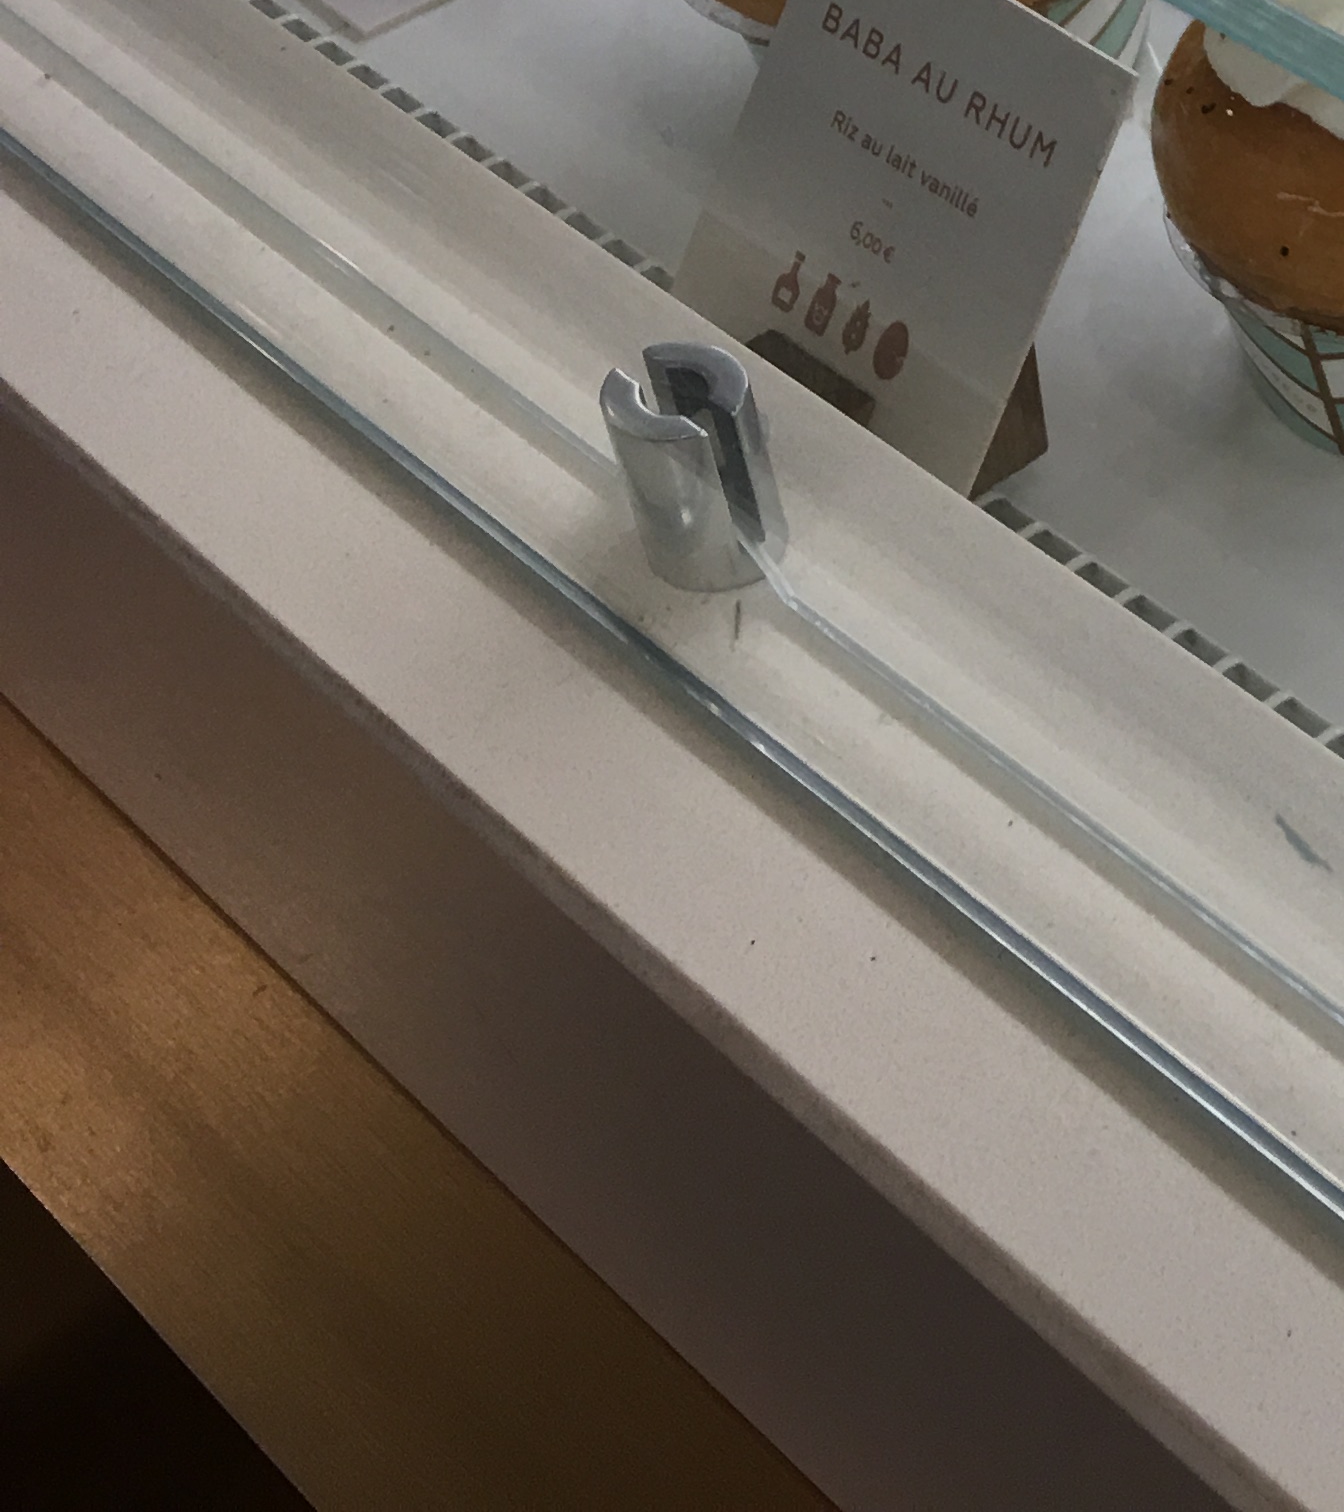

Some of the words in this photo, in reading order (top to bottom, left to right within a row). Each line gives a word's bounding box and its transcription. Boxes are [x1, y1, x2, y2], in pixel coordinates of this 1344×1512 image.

[822, 3, 902, 74] BABA
[911, 62, 959, 104] AU
[964, 91, 1058, 168] RHUM
[831, 110, 860, 141] Riz
[861, 134, 883, 157] au
[886, 145, 917, 178] lait
[920, 170, 980, 219] vanillé
